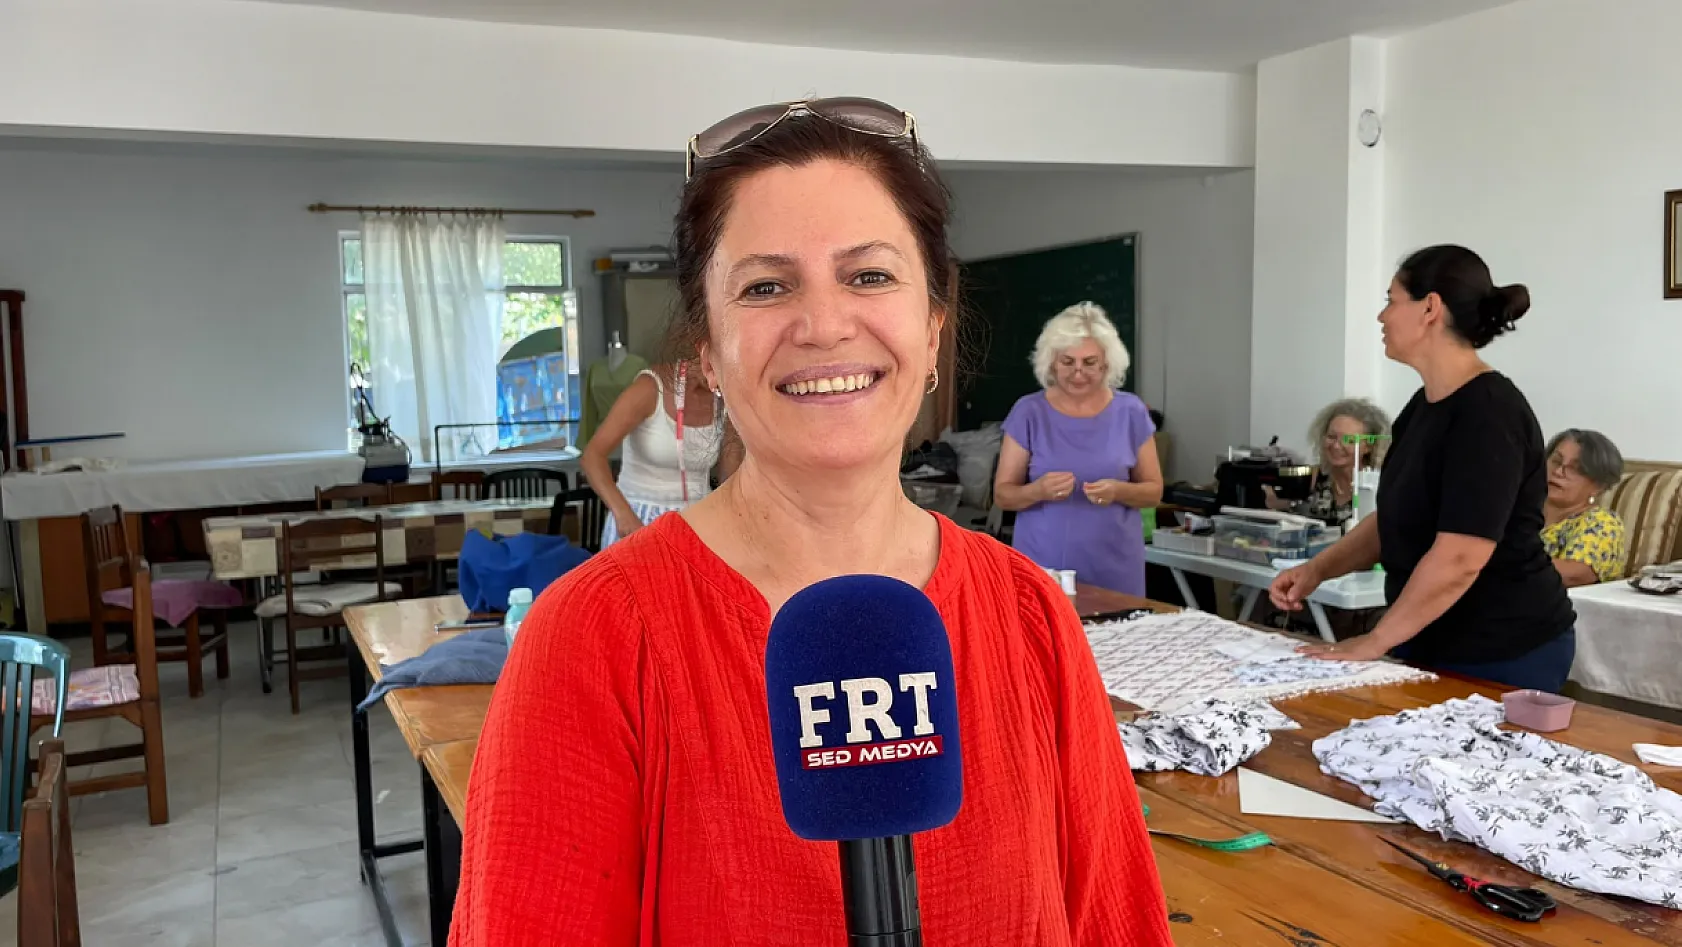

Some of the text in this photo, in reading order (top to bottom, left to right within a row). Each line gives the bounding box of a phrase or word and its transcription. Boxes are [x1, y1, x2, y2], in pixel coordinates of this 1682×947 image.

[793, 671, 938, 748] FRT
[807, 741, 939, 767] SED MEDYA
